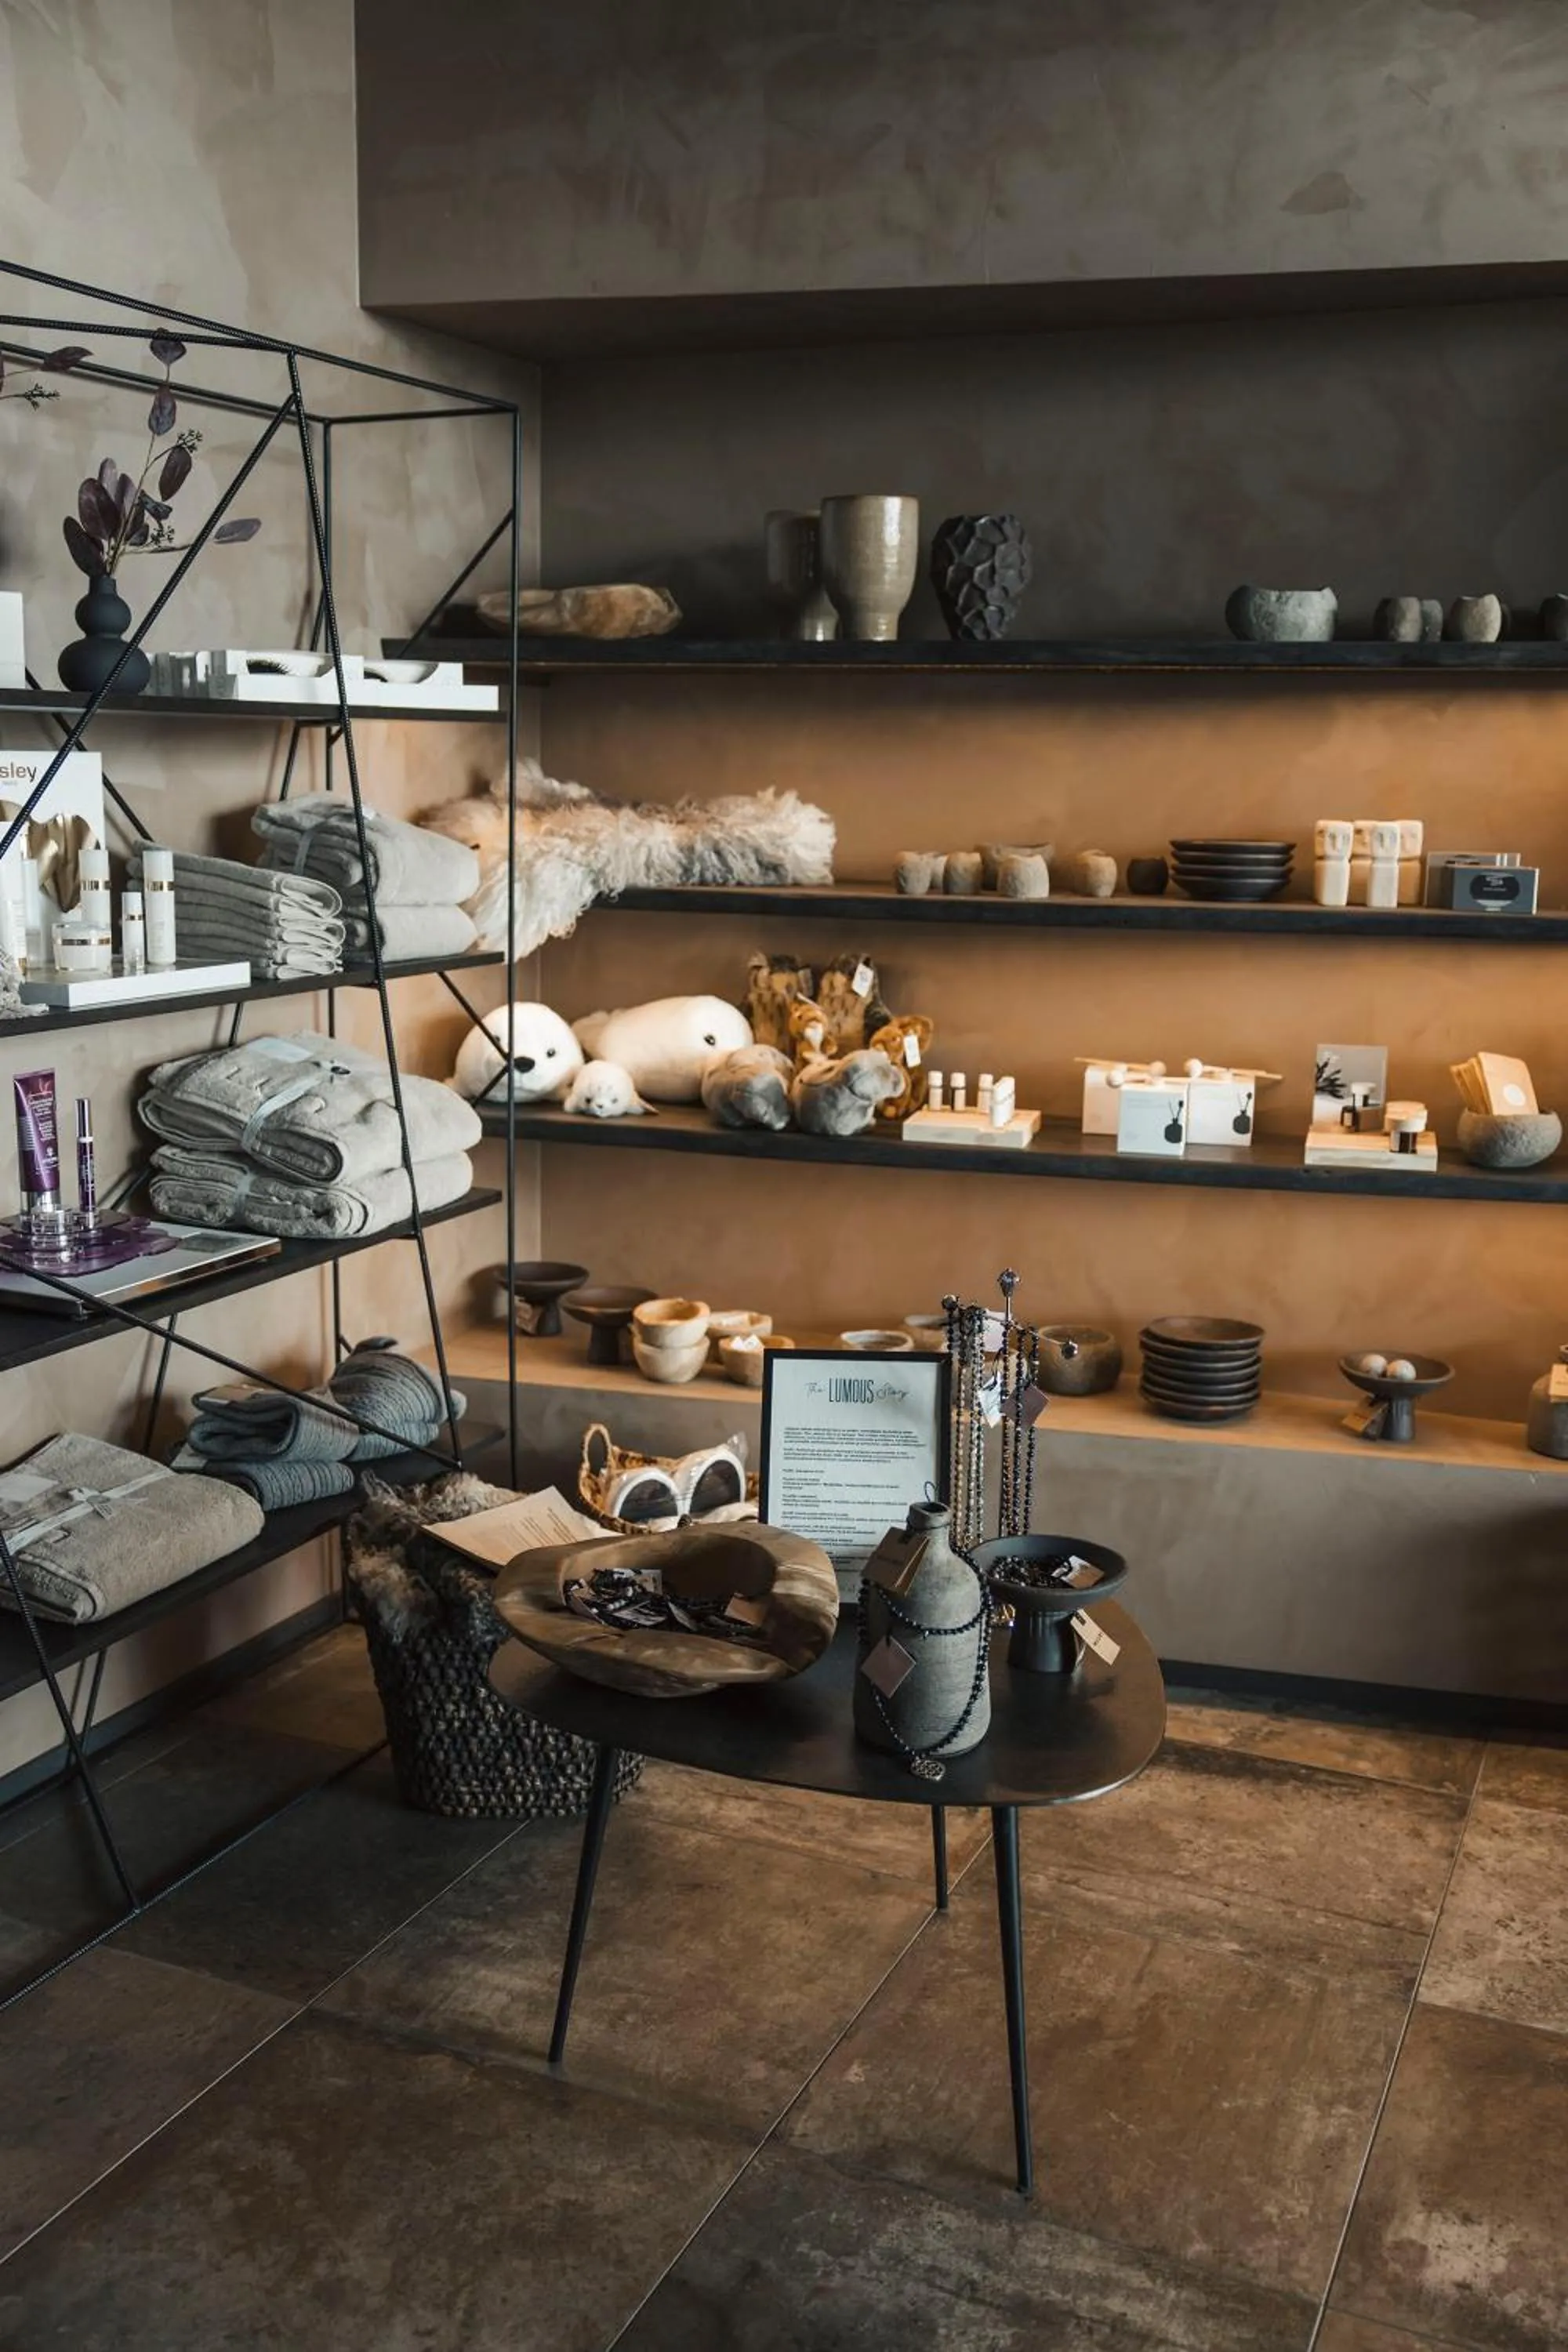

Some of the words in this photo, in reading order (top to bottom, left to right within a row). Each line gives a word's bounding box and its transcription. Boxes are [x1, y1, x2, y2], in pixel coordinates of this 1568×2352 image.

[804, 1382, 825, 1396] The
[829, 1377, 875, 1403] LUMOUS
[876, 1382, 909, 1402] Story
